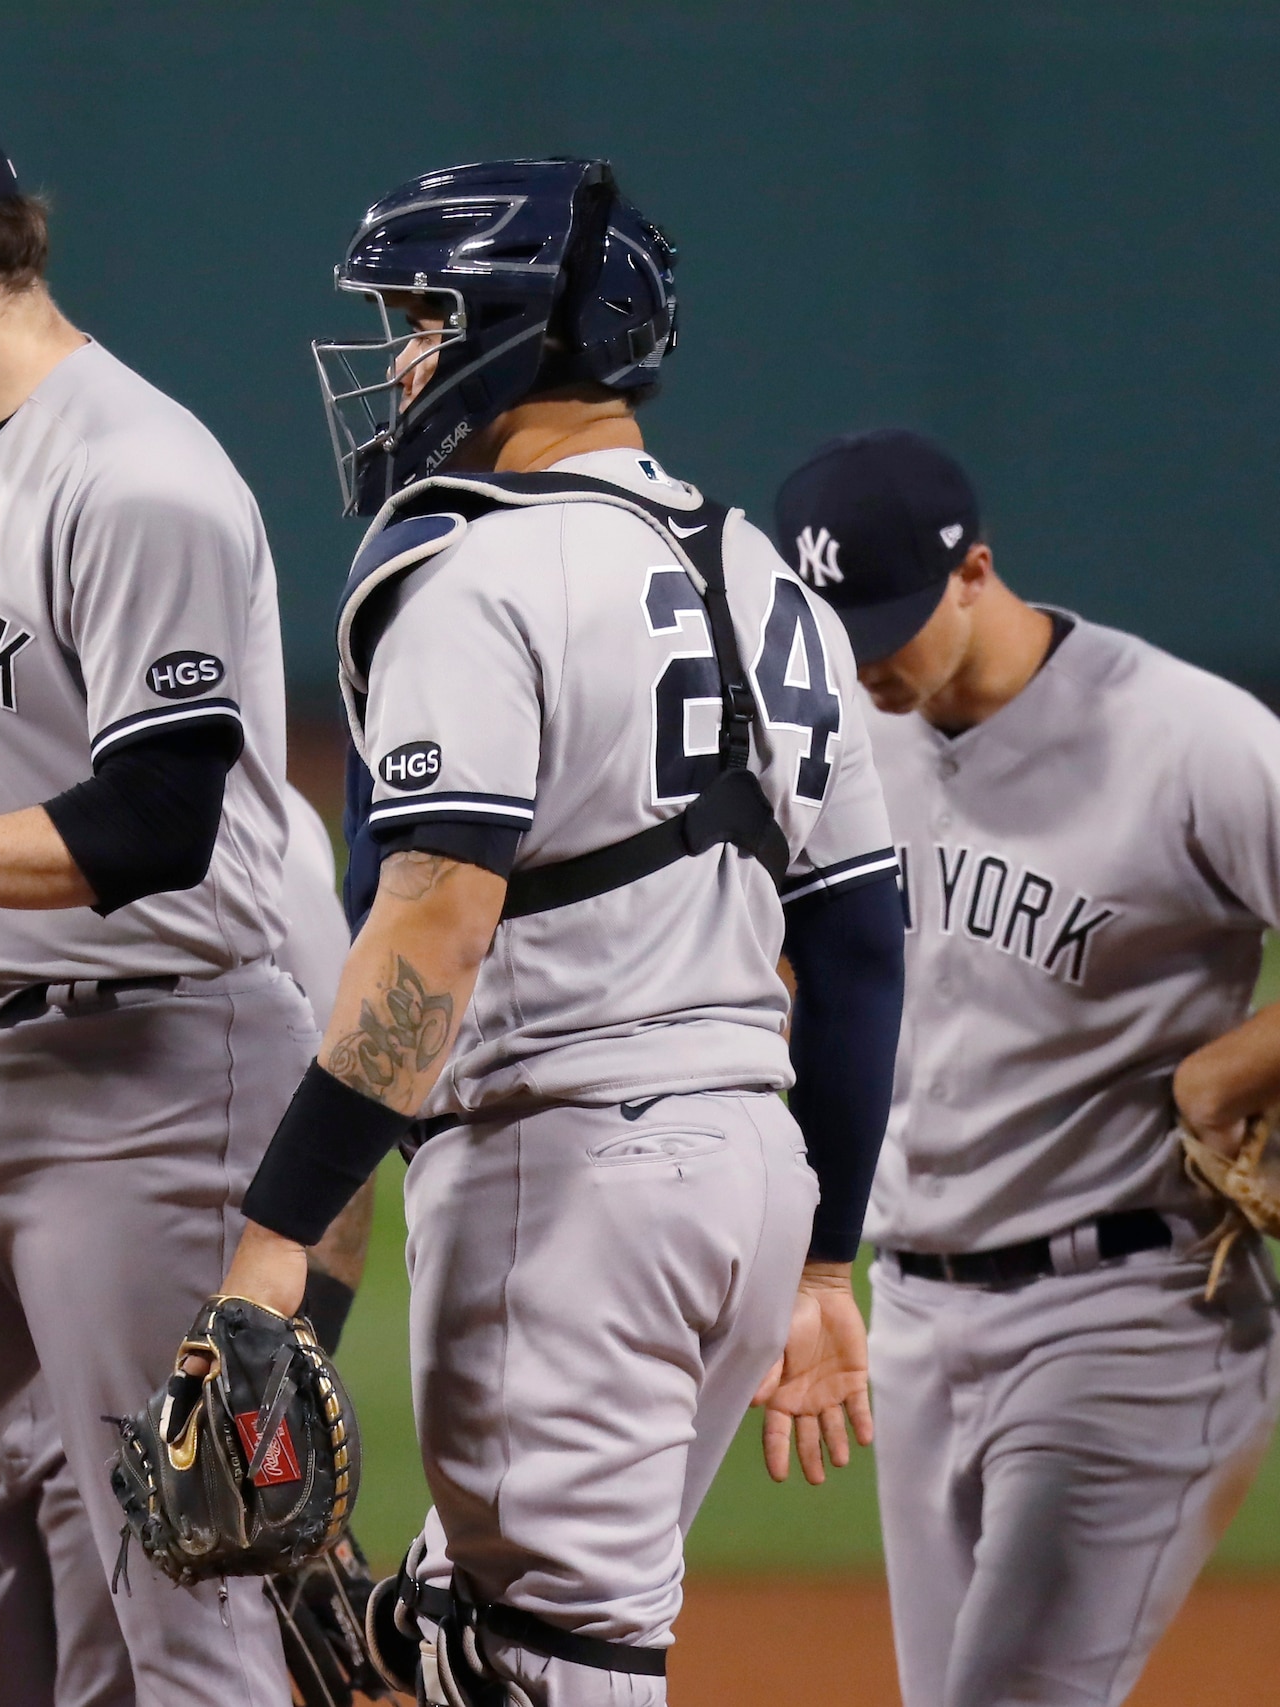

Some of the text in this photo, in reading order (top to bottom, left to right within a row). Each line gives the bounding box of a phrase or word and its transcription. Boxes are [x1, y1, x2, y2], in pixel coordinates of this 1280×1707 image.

[426, 420, 473, 469] ALL-STAR
[795, 525, 845, 588] NY
[151, 658, 220, 693] HGS
[638, 563, 844, 809] 24
[385, 748, 440, 782] HGS
[933, 842, 1119, 987] YORK
